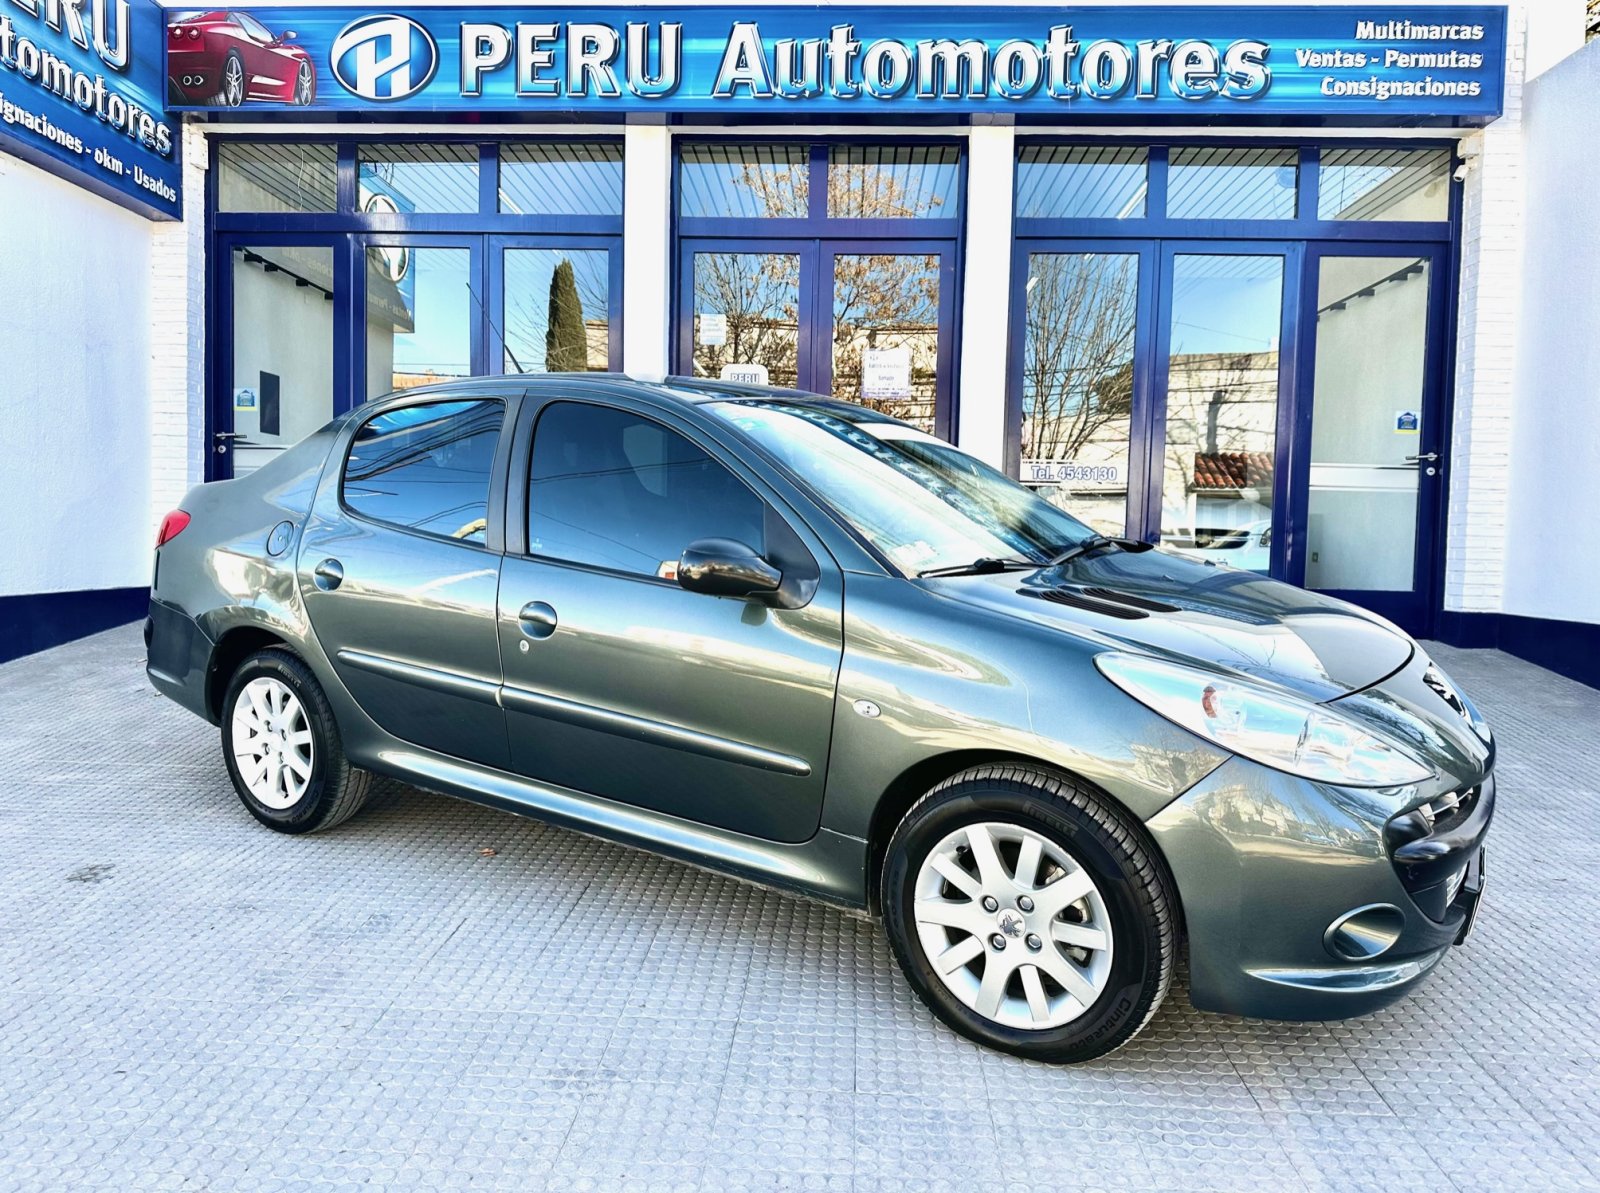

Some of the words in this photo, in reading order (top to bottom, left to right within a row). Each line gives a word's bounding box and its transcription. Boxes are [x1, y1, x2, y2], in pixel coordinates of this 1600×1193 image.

[1355, 20, 1485, 40] Multimarcas
[459, 20, 683, 98] PERU
[711, 20, 1273, 100] Automotores
[1295, 48, 1367, 69] Ventas
[1383, 48, 1484, 69] Permutas
[1320, 75, 1482, 101] Consignaciones
[133, 164, 177, 203] Usados
[730, 373, 760, 384] PERU
[1031, 466, 1055, 481] Tel.
[1057, 466, 1118, 481] 4543130
